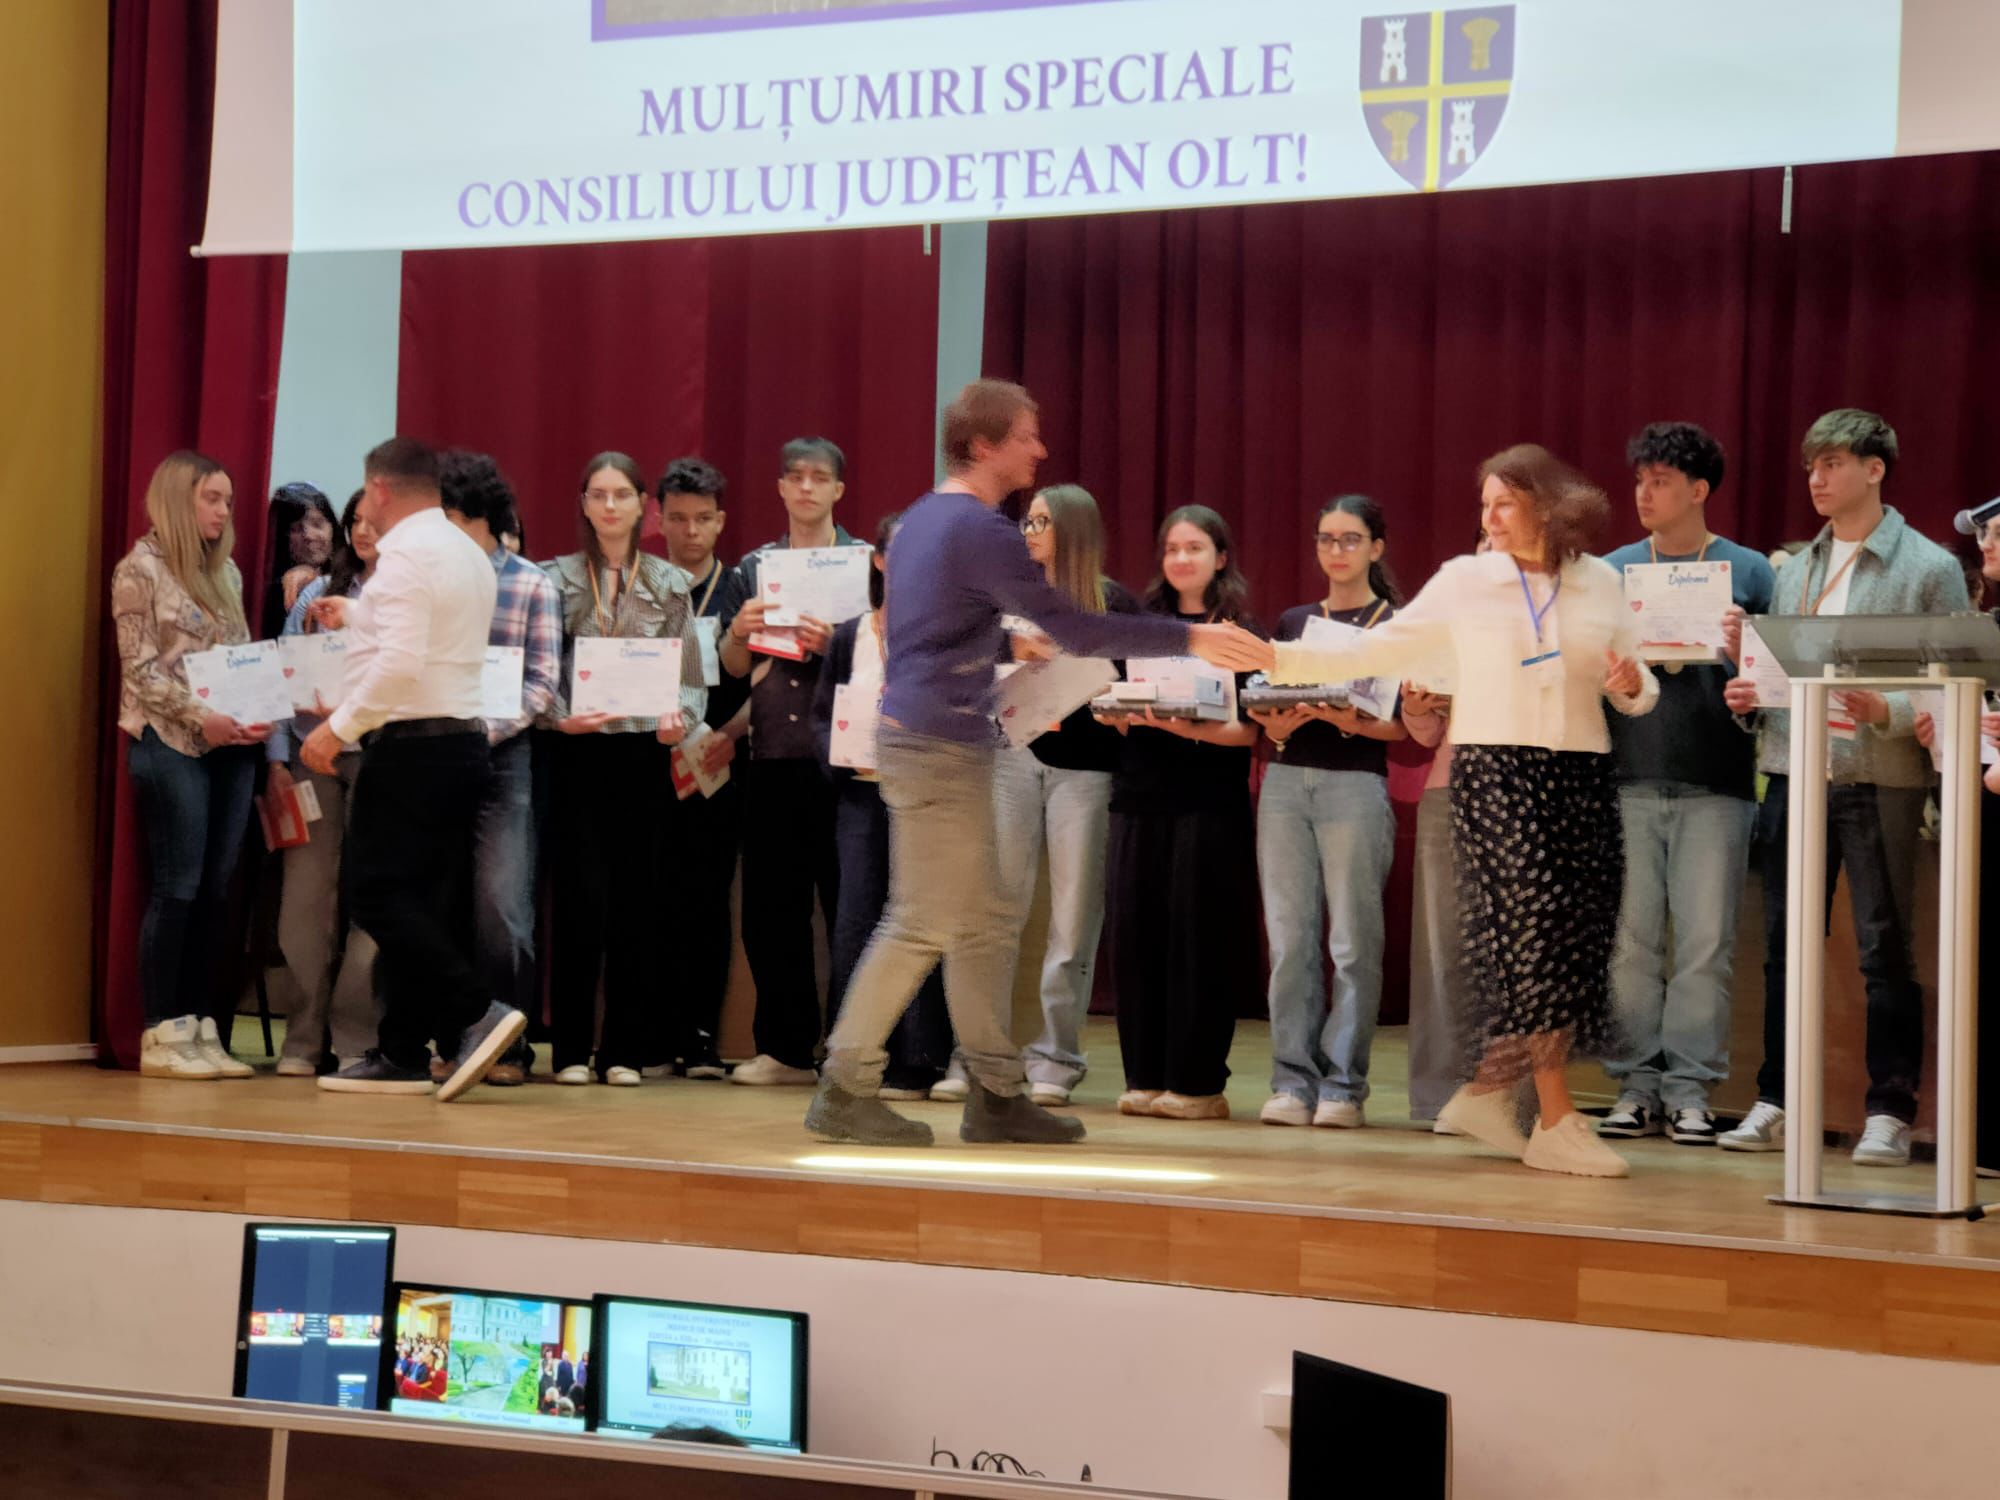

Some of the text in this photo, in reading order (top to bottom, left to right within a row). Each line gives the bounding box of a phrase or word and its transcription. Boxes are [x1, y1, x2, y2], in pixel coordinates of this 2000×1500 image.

[638, 43, 1295, 141] MULȚUMIRI SPECIALE
[457, 133, 1309, 229] CONSILIULUI JUDEȚEAN OLT!
